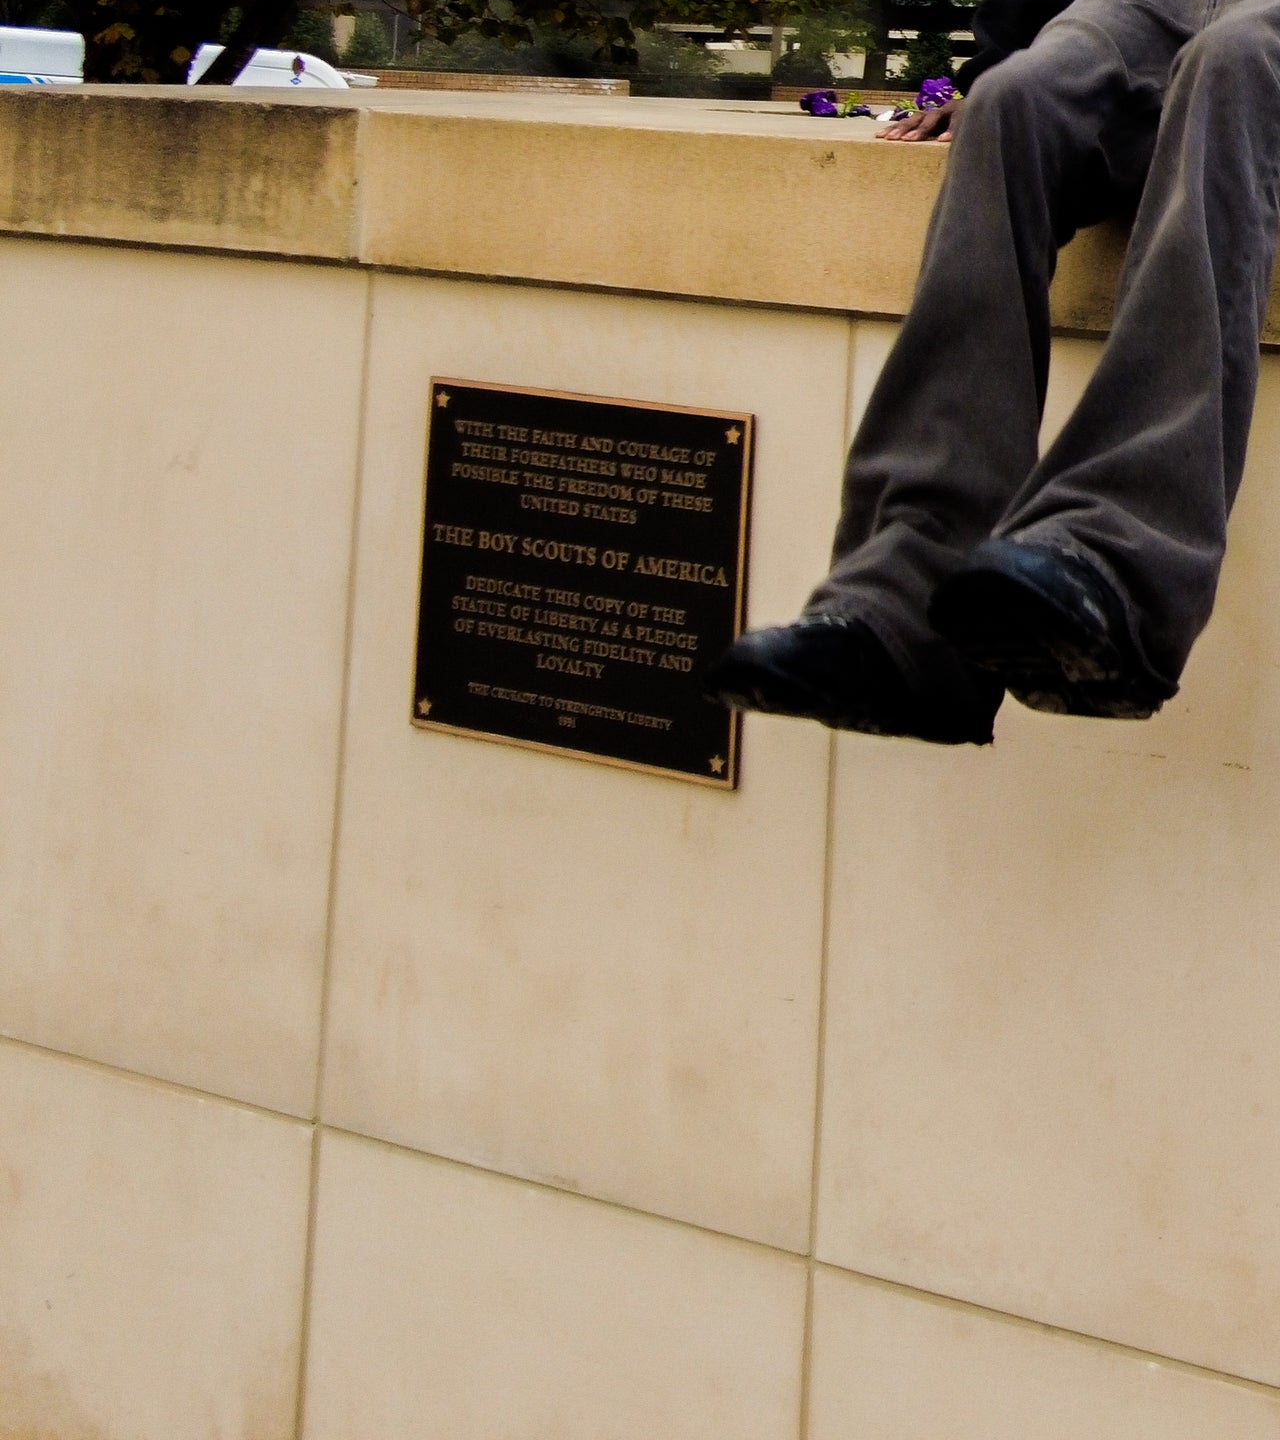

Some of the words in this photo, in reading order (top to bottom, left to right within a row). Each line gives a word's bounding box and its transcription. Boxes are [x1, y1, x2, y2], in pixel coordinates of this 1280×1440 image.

[454, 419, 493, 438] WITH
[498, 424, 528, 442] THE
[532, 429, 577, 448] FAITH
[581, 435, 613, 453] AND
[617, 439, 690, 463] COURAGE
[694, 449, 717, 466] OF
[461, 442, 506, 462] THEIR
[511, 448, 616, 476] FOREFATHERS
[621, 463, 657, 482] WHO
[661, 468, 707, 488] MADE
[451, 462, 518, 485] POSSIBLE
[524, 472, 554, 490] THE
[558, 477, 633, 501] FREEDOM
[637, 488, 657, 504] OF
[662, 491, 714, 512] THESE
[520, 493, 579, 516] UNITED
[583, 503, 638, 525] STATES
[432, 523, 473, 547] THE
[479, 530, 517, 554] BOY
[522, 537, 596, 566] SCOUTS
[602, 549, 629, 571] OF
[634, 554, 730, 587] AMERICA
[451, 594, 506, 617] STATUE
[511, 604, 530, 621] OF
[534, 608, 599, 633] LIBERTY
[601, 619, 618, 636] AS
[623, 623, 633, 639] A
[636, 625, 698, 650] PLEDGE
[465, 575, 541, 601] DEDICATE
[546, 588, 580, 608] THIS
[584, 594, 624, 615] COPY
[628, 601, 648, 619] OF
[652, 605, 686, 625] THE
[453, 617, 474, 635] OF
[478, 621, 579, 652] EVERLASTING
[584, 639, 655, 665] FIDELITY
[659, 652, 693, 672] AND
[536, 653, 606, 679] LOYALTY
[467, 680, 490, 697] THE
[539, 694, 553, 709] TO
[628, 711, 673, 732] LIBERTY
